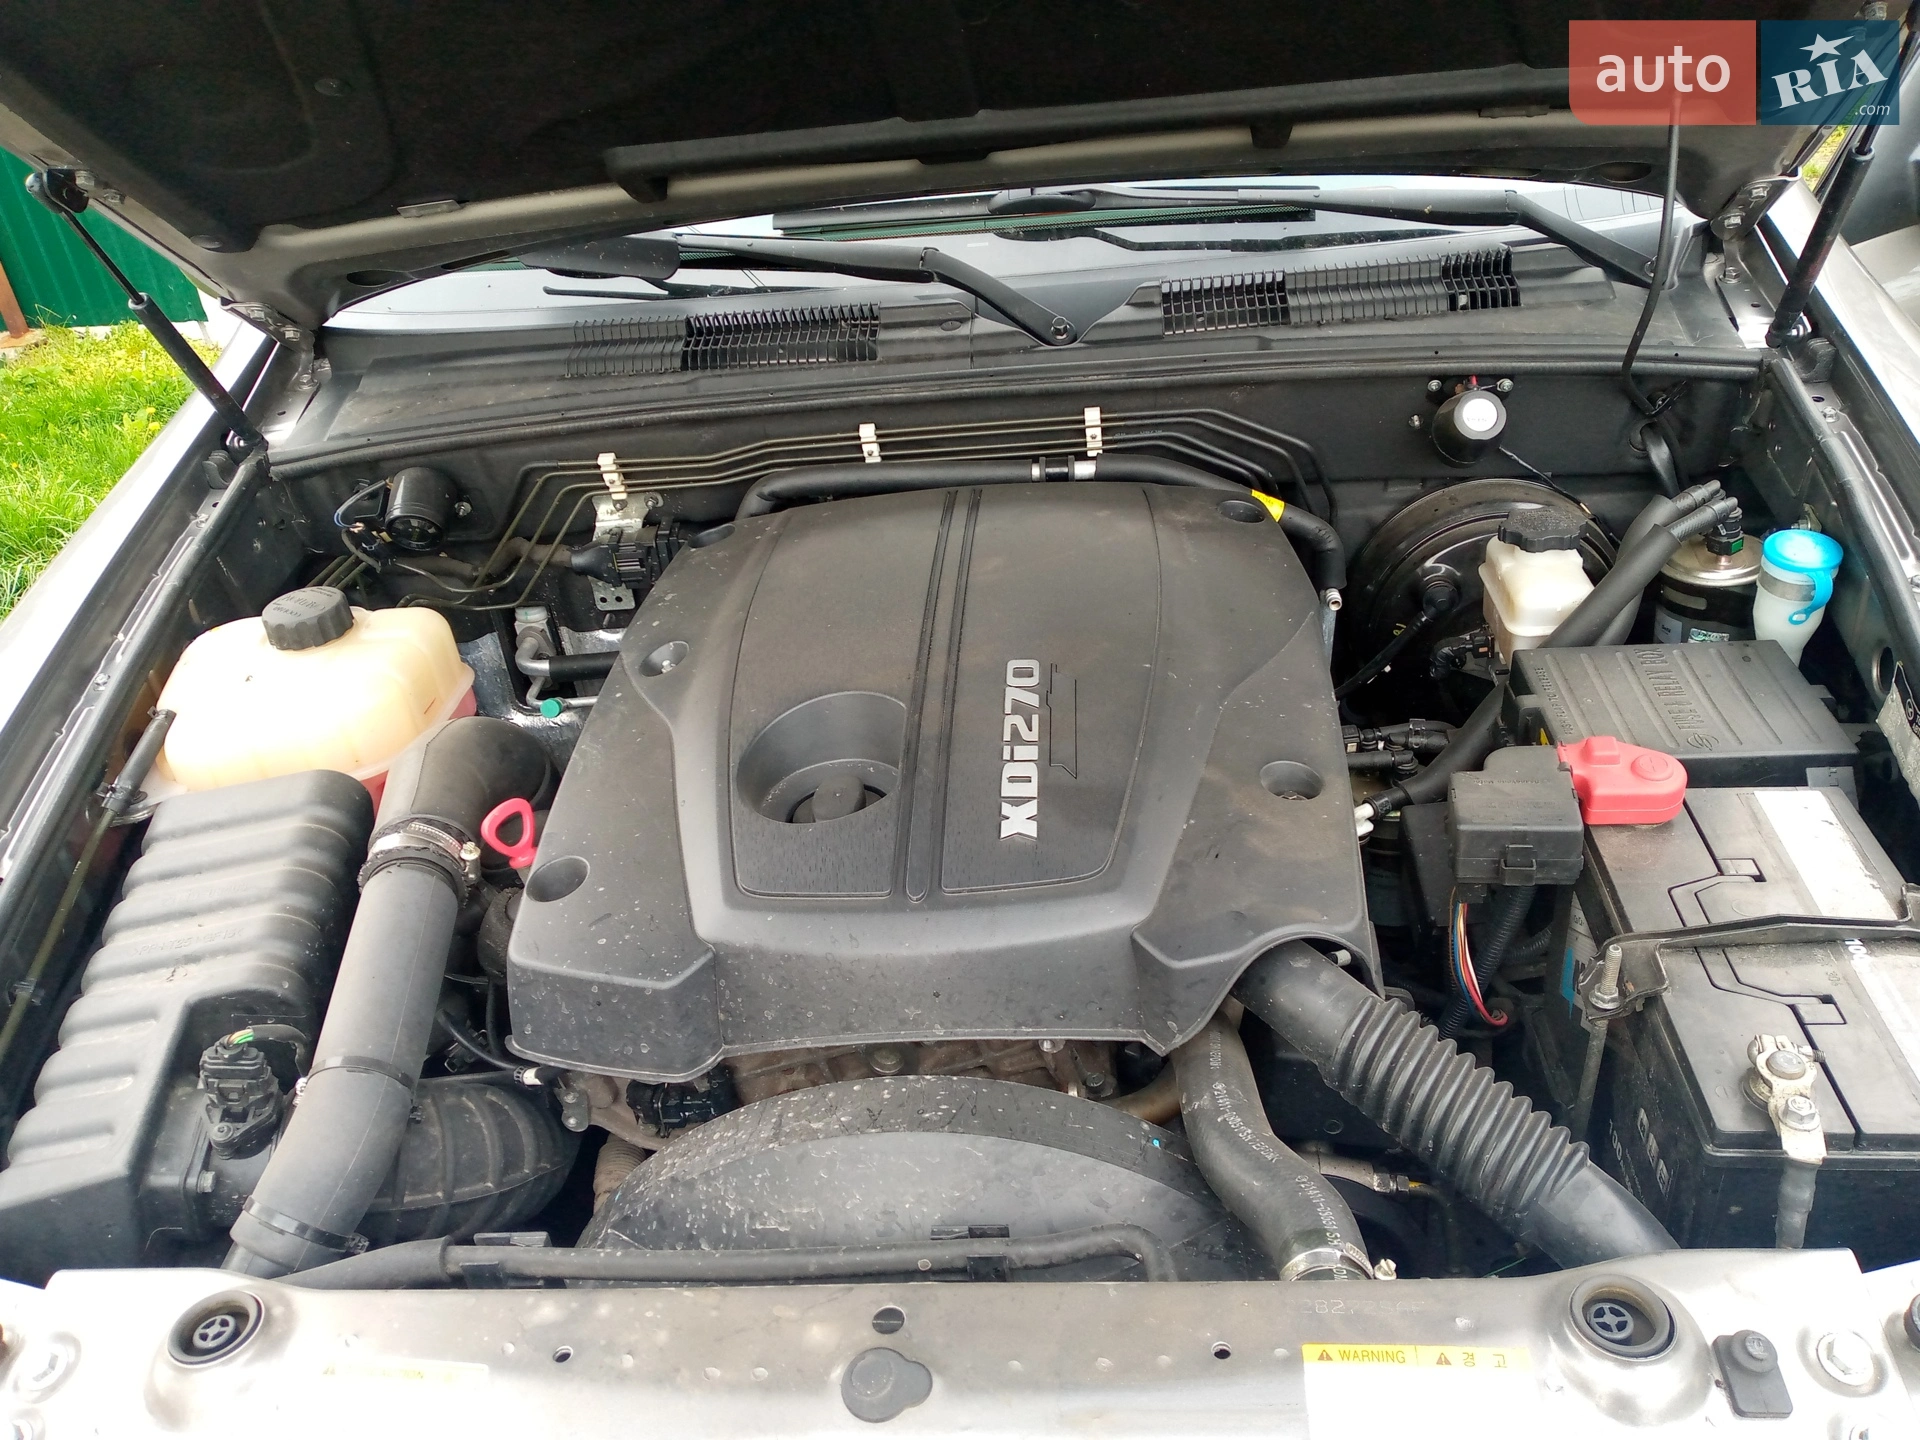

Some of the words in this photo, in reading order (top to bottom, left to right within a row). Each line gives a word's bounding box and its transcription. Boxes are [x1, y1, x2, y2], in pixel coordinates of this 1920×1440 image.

[1633, 647, 1669, 665] BOX
[1645, 669, 1687, 697] RELAY
[1667, 708, 1709, 730] FUSE
[1000, 659, 1040, 840] XDi270
[1338, 1349, 1406, 1364] WARNING
